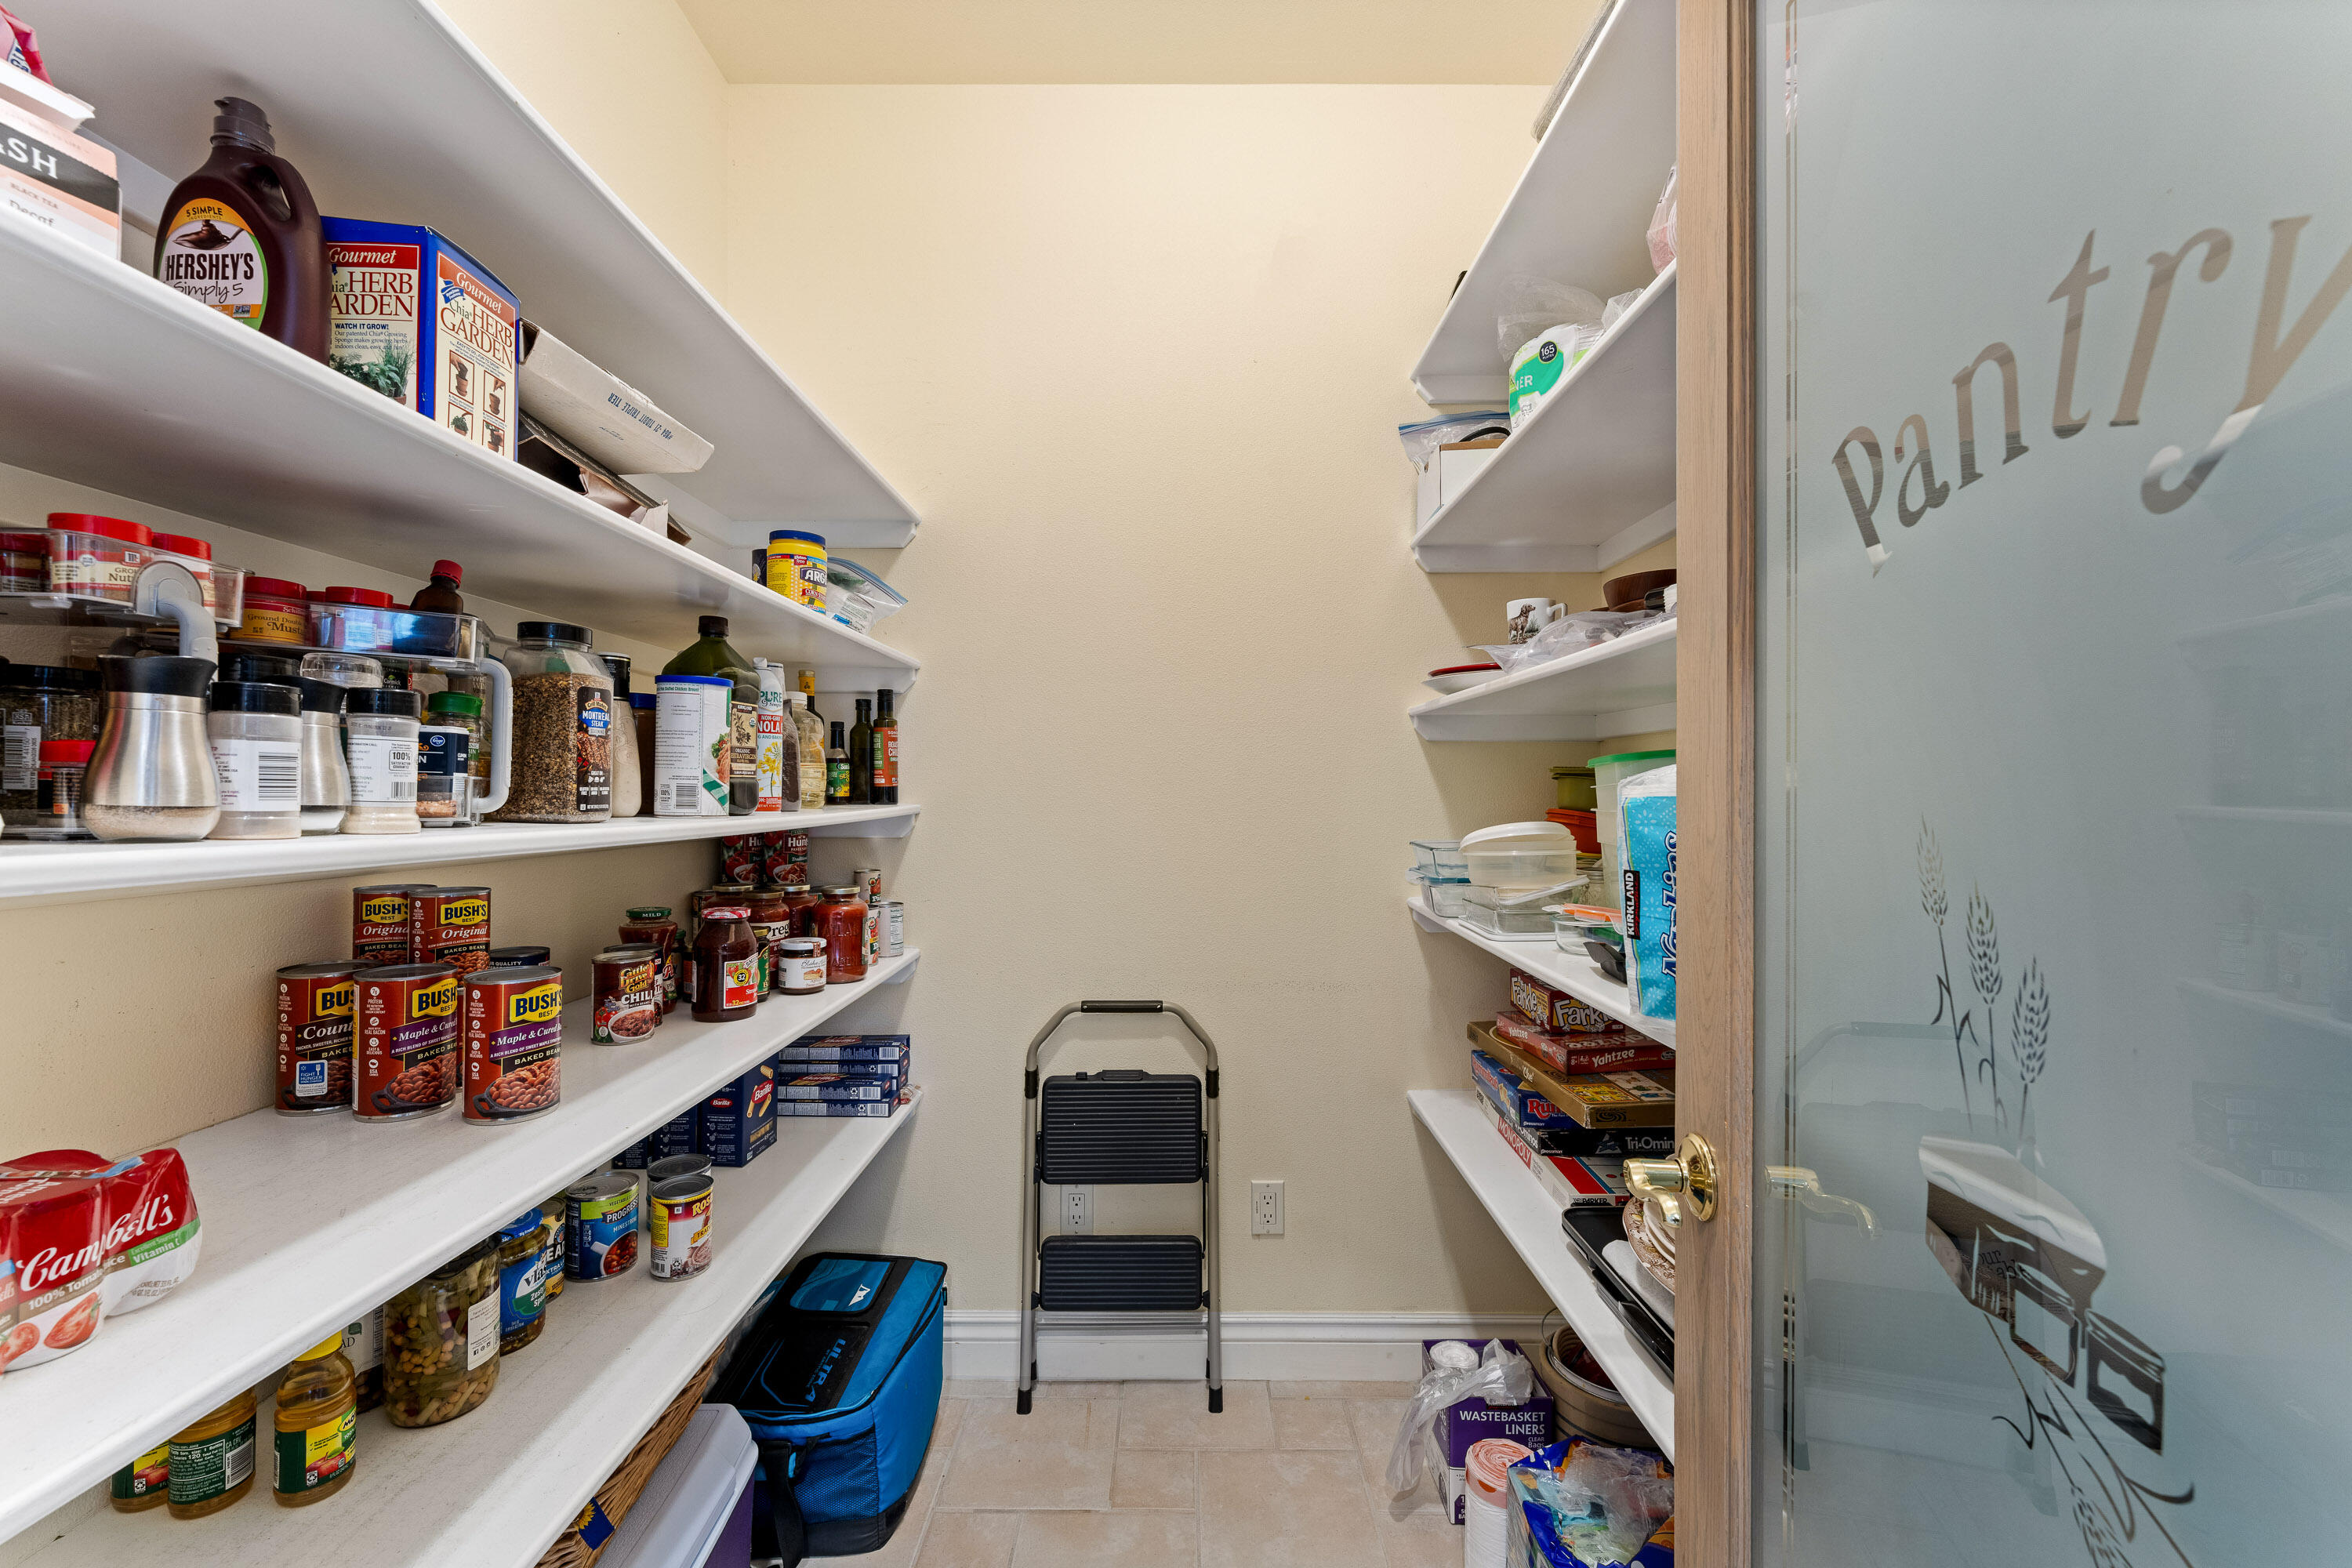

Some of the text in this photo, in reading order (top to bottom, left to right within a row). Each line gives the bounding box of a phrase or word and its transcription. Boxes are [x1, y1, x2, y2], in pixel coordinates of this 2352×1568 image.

[0, 135, 59, 180] SH
[186, 205, 223, 218] 5 SIMPLE
[329, 247, 397, 264] Gourmet
[165, 252, 254, 281] HERSHEY'S
[347, 270, 413, 295] HERB
[173, 281, 244, 304] Simply 5
[456, 271, 503, 314] Gourmet
[331, 292, 416, 318] ARDEN
[471, 302, 513, 348] HERB
[440, 307, 514, 370] GARDEN
[1541, 343, 1555, 358] 165
[607, 391, 622, 408] TIER
[621, 401, 641, 419] TRIPLE
[247, 613, 280, 622] Ground
[267, 621, 303, 635] Must
[760, 691, 782, 703] PURE
[582, 710, 611, 722] MONTREAL
[590, 719, 604, 728] STEAK
[757, 720, 780, 733] NOLA
[392, 752, 411, 760] 100%
[444, 903, 488, 921] BUSH'S
[1624, 871, 1635, 936] KIRKLAND
[362, 924, 408, 936] Origina
[441, 925, 488, 939] Original
[625, 979, 648, 993] Gold
[738, 973, 746, 982] 32
[321, 989, 354, 1011] BUS
[418, 986, 458, 1013] BUSH'
[1511, 975, 1538, 1013] Farkle
[440, 1004, 453, 1013] BEST
[515, 989, 563, 1018] BUSH'S
[538, 1009, 554, 1018] BEST
[1554, 999, 1617, 1028] Fark
[303, 1021, 353, 1040] Count
[398, 1027, 430, 1042] Maple
[496, 1023, 557, 1047] Maple & Cured
[1508, 1026, 1529, 1040] Yahtzee
[407, 1042, 422, 1051] BLEND
[417, 1046, 446, 1060] BAKED
[525, 1043, 539, 1051] SWEET
[514, 1047, 561, 1065] BAKED BEANS
[1592, 1049, 1635, 1068] Yahtzee
[754, 1083, 772, 1102] Barilla
[1498, 1116, 1531, 1164] MONOPOLY
[16, 1193, 174, 1293] Campbell's
[132, 1242, 174, 1265] Vitamin
[28, 1287, 65, 1312] 100%
[804, 1338, 847, 1403] ULTRA
[1459, 1410, 1546, 1422] WASTEBASKET
[1505, 1424, 1545, 1436] LINERS
